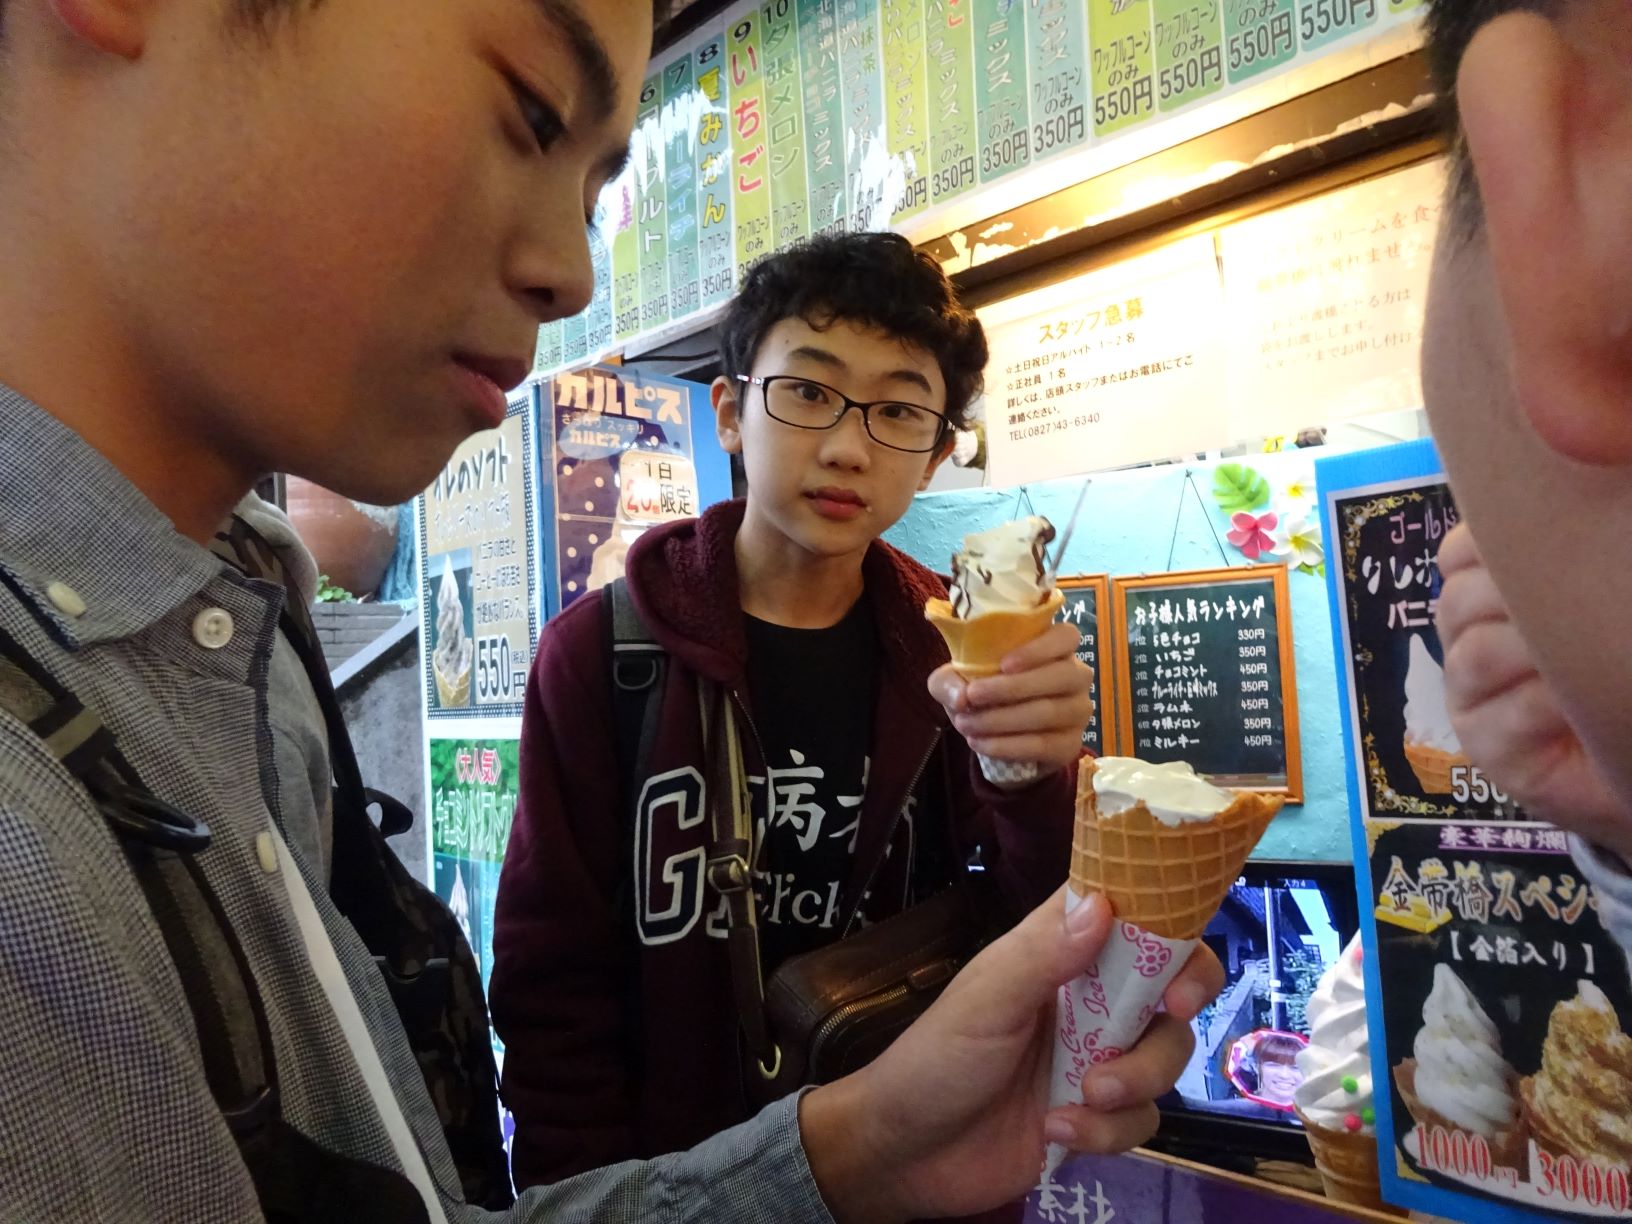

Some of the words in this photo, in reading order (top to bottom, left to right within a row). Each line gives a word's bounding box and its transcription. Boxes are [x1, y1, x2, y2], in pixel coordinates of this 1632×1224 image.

[763, 0, 789, 24] 10
[733, 20, 752, 43] 9
[1230, 11, 1292, 69] 550円
[698, 42, 720, 65] 8
[1094, 31, 1151, 75] ワッフルコーン
[1172, 34, 1206, 58] のみ
[670, 63, 687, 86] 7
[1108, 63, 1140, 87] のみ
[1160, 45, 1222, 99] 550円
[640, 84, 656, 104] 6
[764, 22, 801, 179] 夕張メロン
[1044, 92, 1075, 114] のみ
[1094, 75, 1153, 126] 550円
[730, 45, 765, 194] いちご
[988, 113, 1016, 140] のみ
[1034, 104, 1085, 153] 350円
[941, 144, 964, 163] のみ
[983, 129, 1029, 174] 350円
[932, 156, 975, 197] 350円
[745, 237, 764, 253] のみ
[671, 281, 698, 310] 350円
[702, 267, 732, 298] 350円
[615, 307, 639, 335] 350円
[641, 294, 668, 321] 350円
[1039, 298, 1146, 344] スタッフ急募
[564, 335, 587, 358] 350円
[588, 324, 612, 348] 350円
[538, 345, 561, 367] 350円
[556, 371, 683, 426] カルピス
[569, 428, 621, 449] カルピス
[1134, 595, 1265, 626] お子様人気ランキング
[478, 635, 526, 699] 550円
[1155, 647, 1196, 662] いちご
[1239, 645, 1266, 658] 350円
[1154, 663, 1208, 680] チョコミント
[1239, 662, 1268, 675] 450円
[1240, 680, 1269, 692] 350円
[1240, 698, 1269, 710] 450円
[1151, 715, 1201, 731] 夕張メロン
[1243, 717, 1272, 730] 350円
[1153, 733, 1200, 749] ミルキー
[1244, 734, 1273, 748] 450円
[1381, 855, 1600, 925] 金帯橋スペシ
[1083, 981, 1110, 1020] Ice
[1536, 1150, 1630, 1216] 3000
